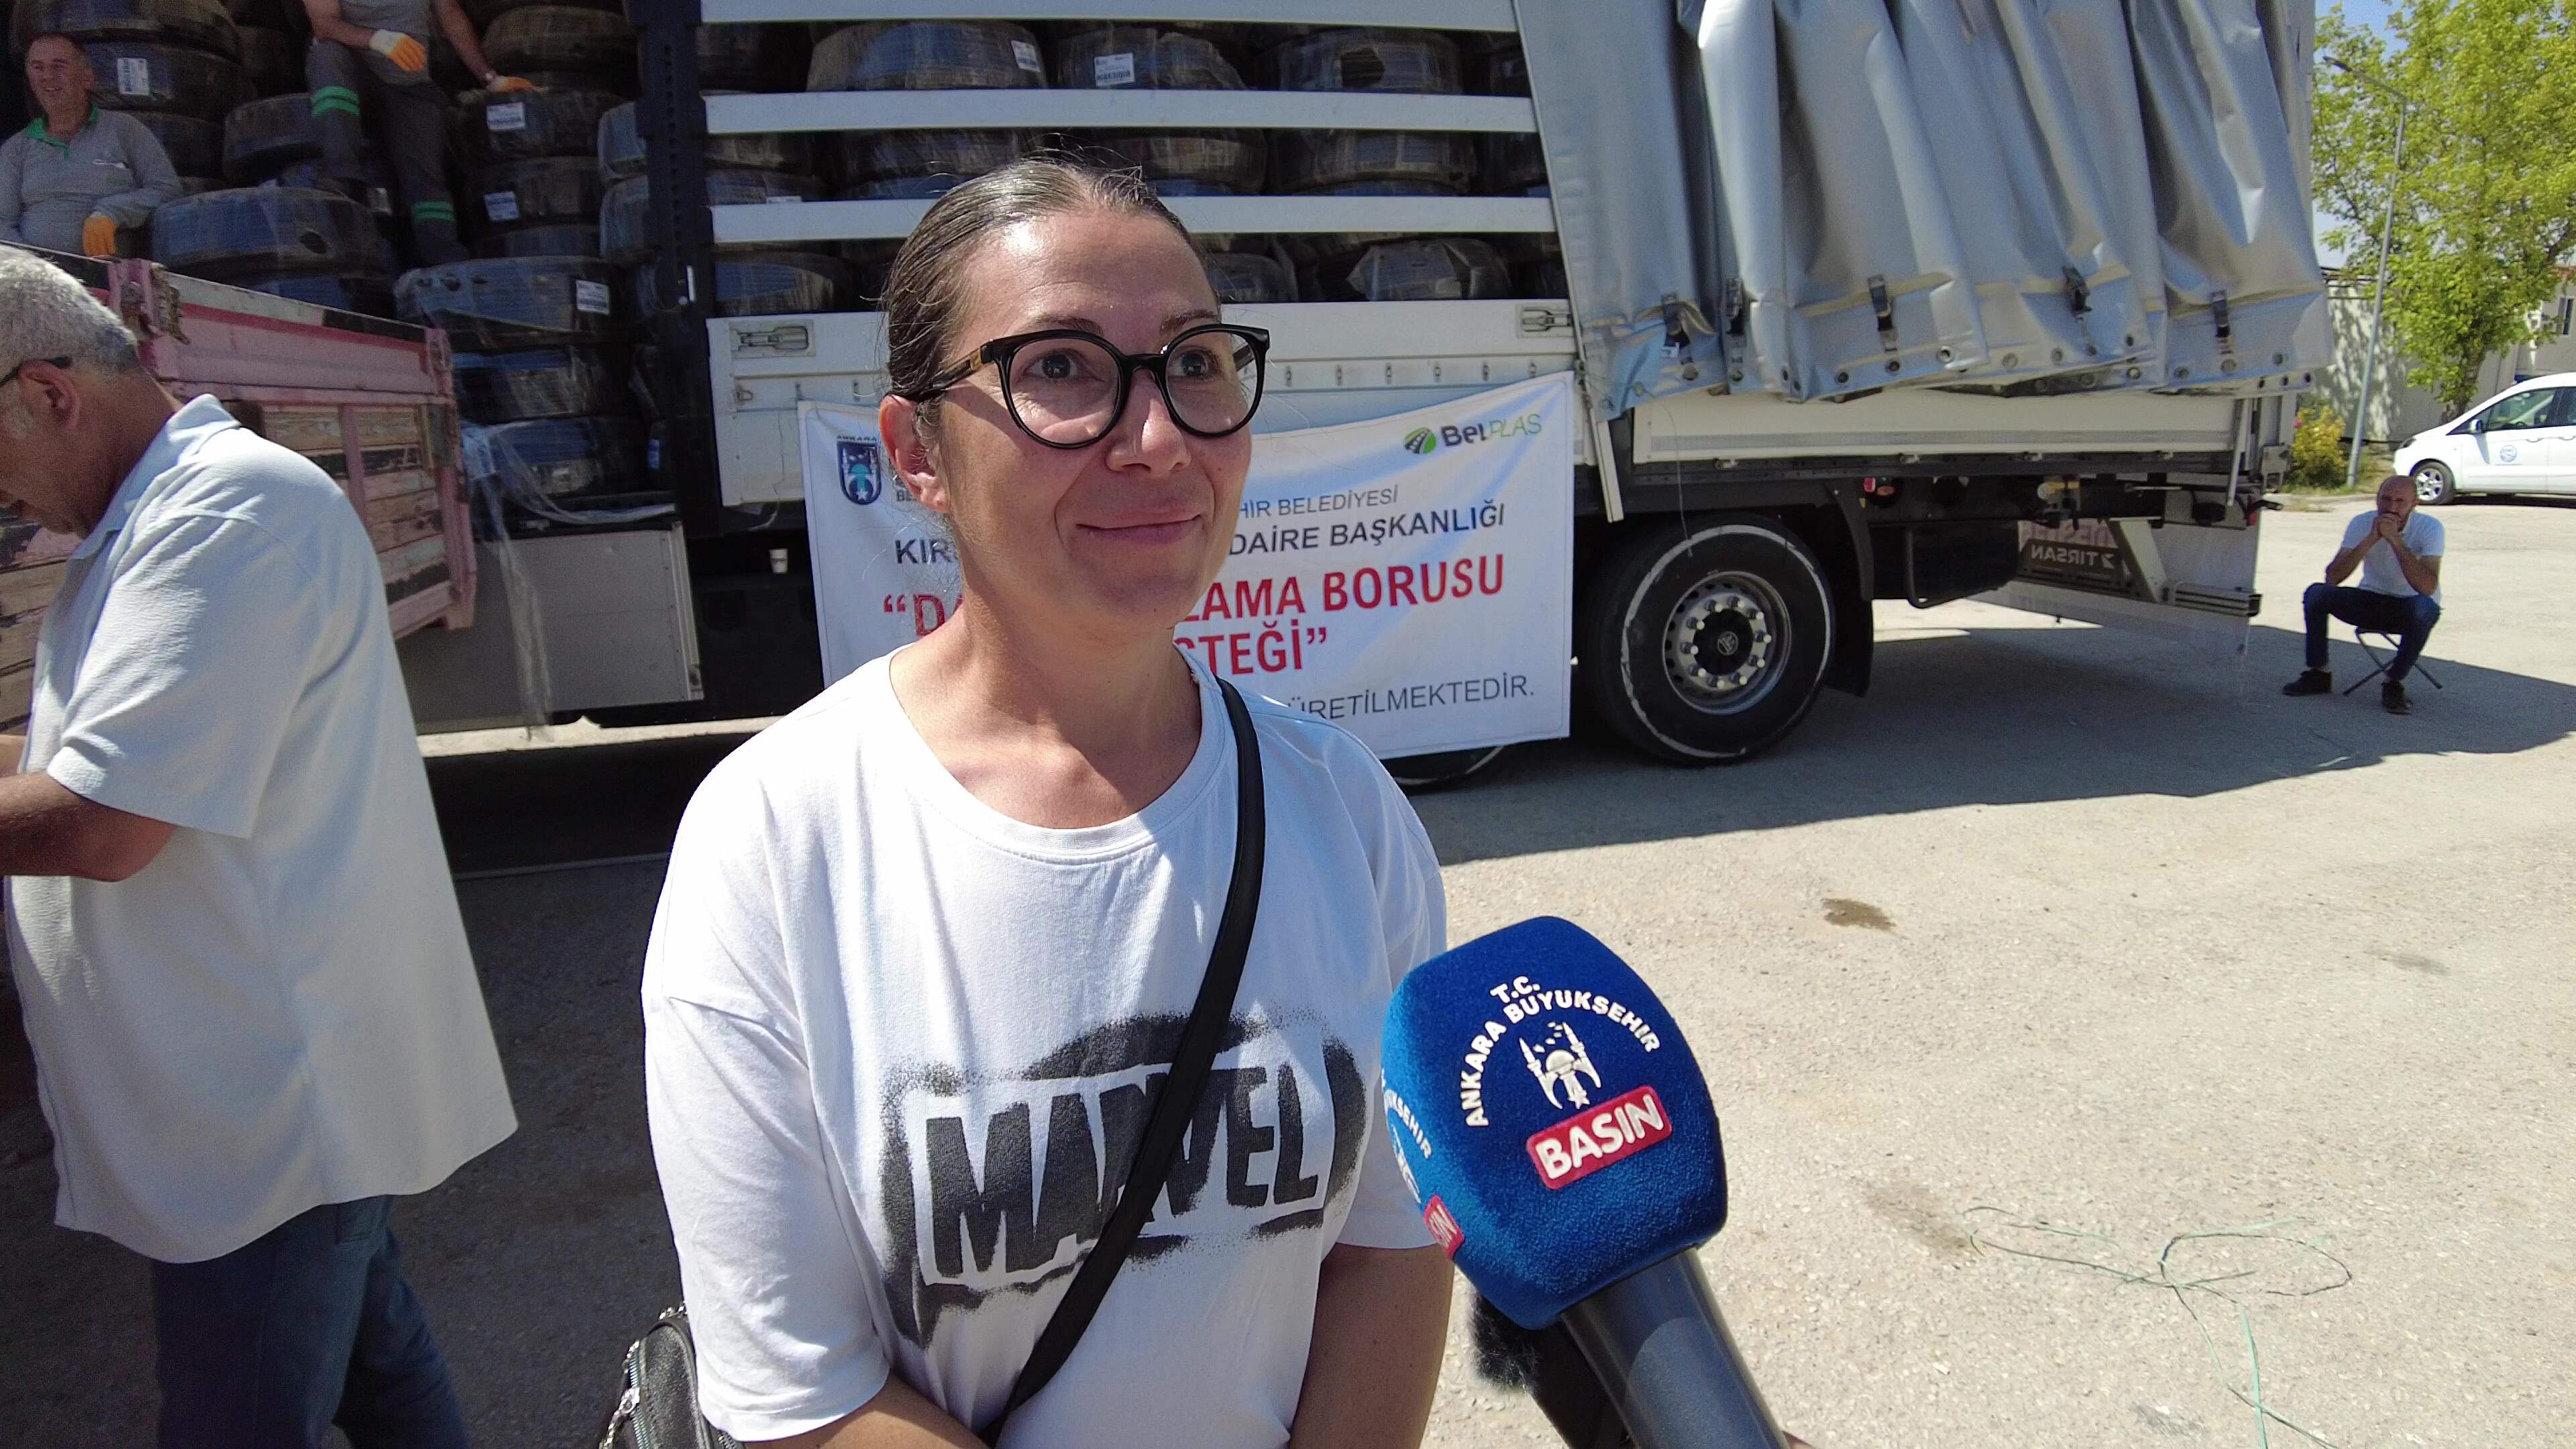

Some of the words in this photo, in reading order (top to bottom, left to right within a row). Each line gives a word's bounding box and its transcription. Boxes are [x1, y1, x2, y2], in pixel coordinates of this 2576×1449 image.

[895, 539, 958, 564] KIR
[1229, 525, 1320, 555] DAİRE
[1330, 498, 1504, 547] BAŞKANLIĞI
[1279, 484, 1398, 516] BELEDİYESİ
[1182, 576, 1306, 623] AMA
[1323, 554, 1503, 612] BORUSU
[1490, 976, 1541, 1004] T.C.
[1460, 1020, 1507, 1127] ANKARA
[1503, 989, 1660, 1053] BUYUKSEHIR
[1535, 1093, 1664, 1179] BASIN
